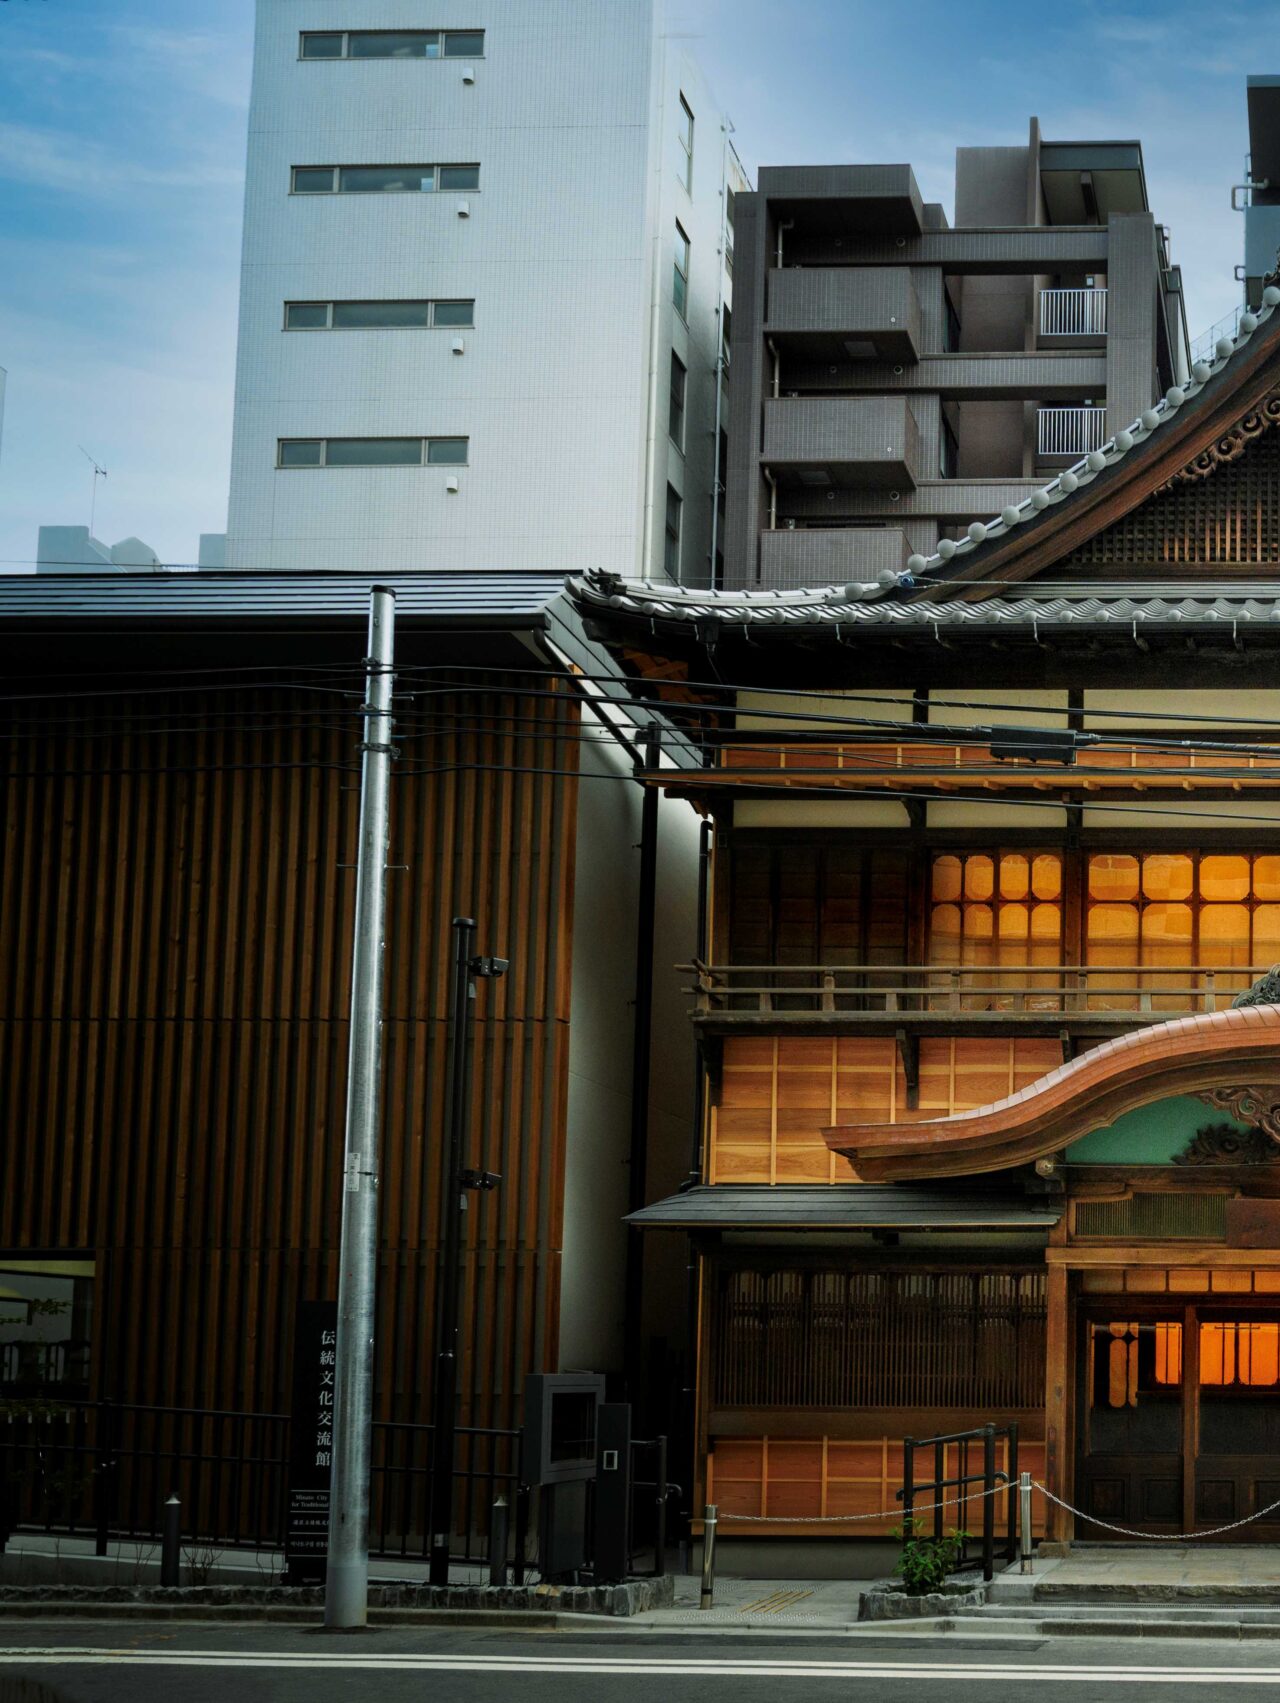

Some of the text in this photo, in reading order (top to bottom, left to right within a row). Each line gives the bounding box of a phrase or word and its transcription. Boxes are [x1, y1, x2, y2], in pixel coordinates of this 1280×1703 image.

[315, 1330, 336, 1467] 伝統文化交流館
